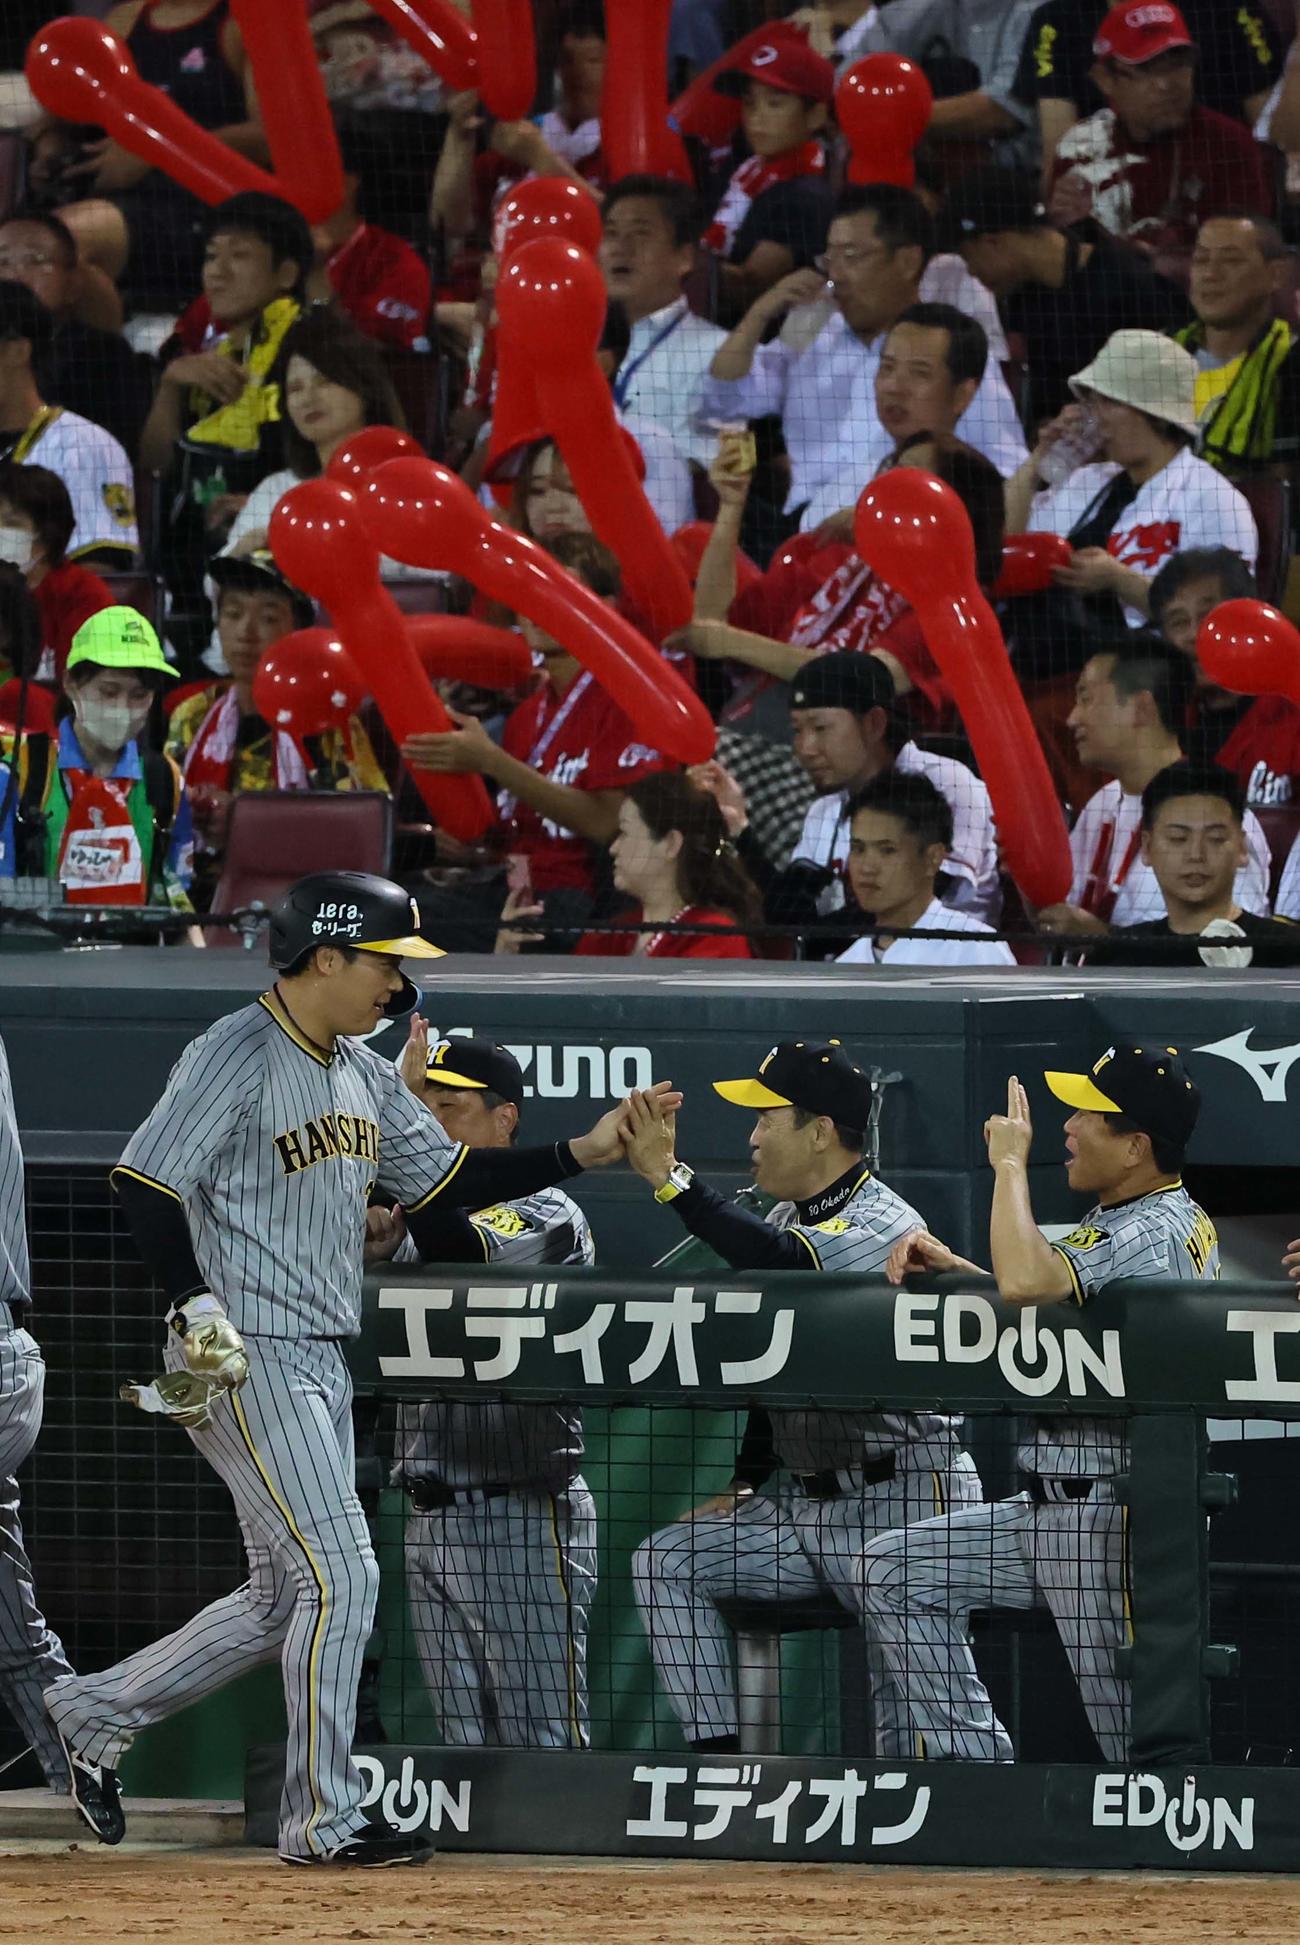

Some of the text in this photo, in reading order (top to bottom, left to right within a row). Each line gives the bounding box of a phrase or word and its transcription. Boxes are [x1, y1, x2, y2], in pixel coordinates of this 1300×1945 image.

[272, 1110, 380, 1176] HANSHI
[820, 1187, 850, 1211] Okada
[378, 1283, 795, 1385] エディオン
[893, 1293, 1125, 1398] EDION
[350, 1755, 472, 1833] DION
[626, 1763, 931, 1846] エディオン
[1093, 1773, 1254, 1851] EDION
